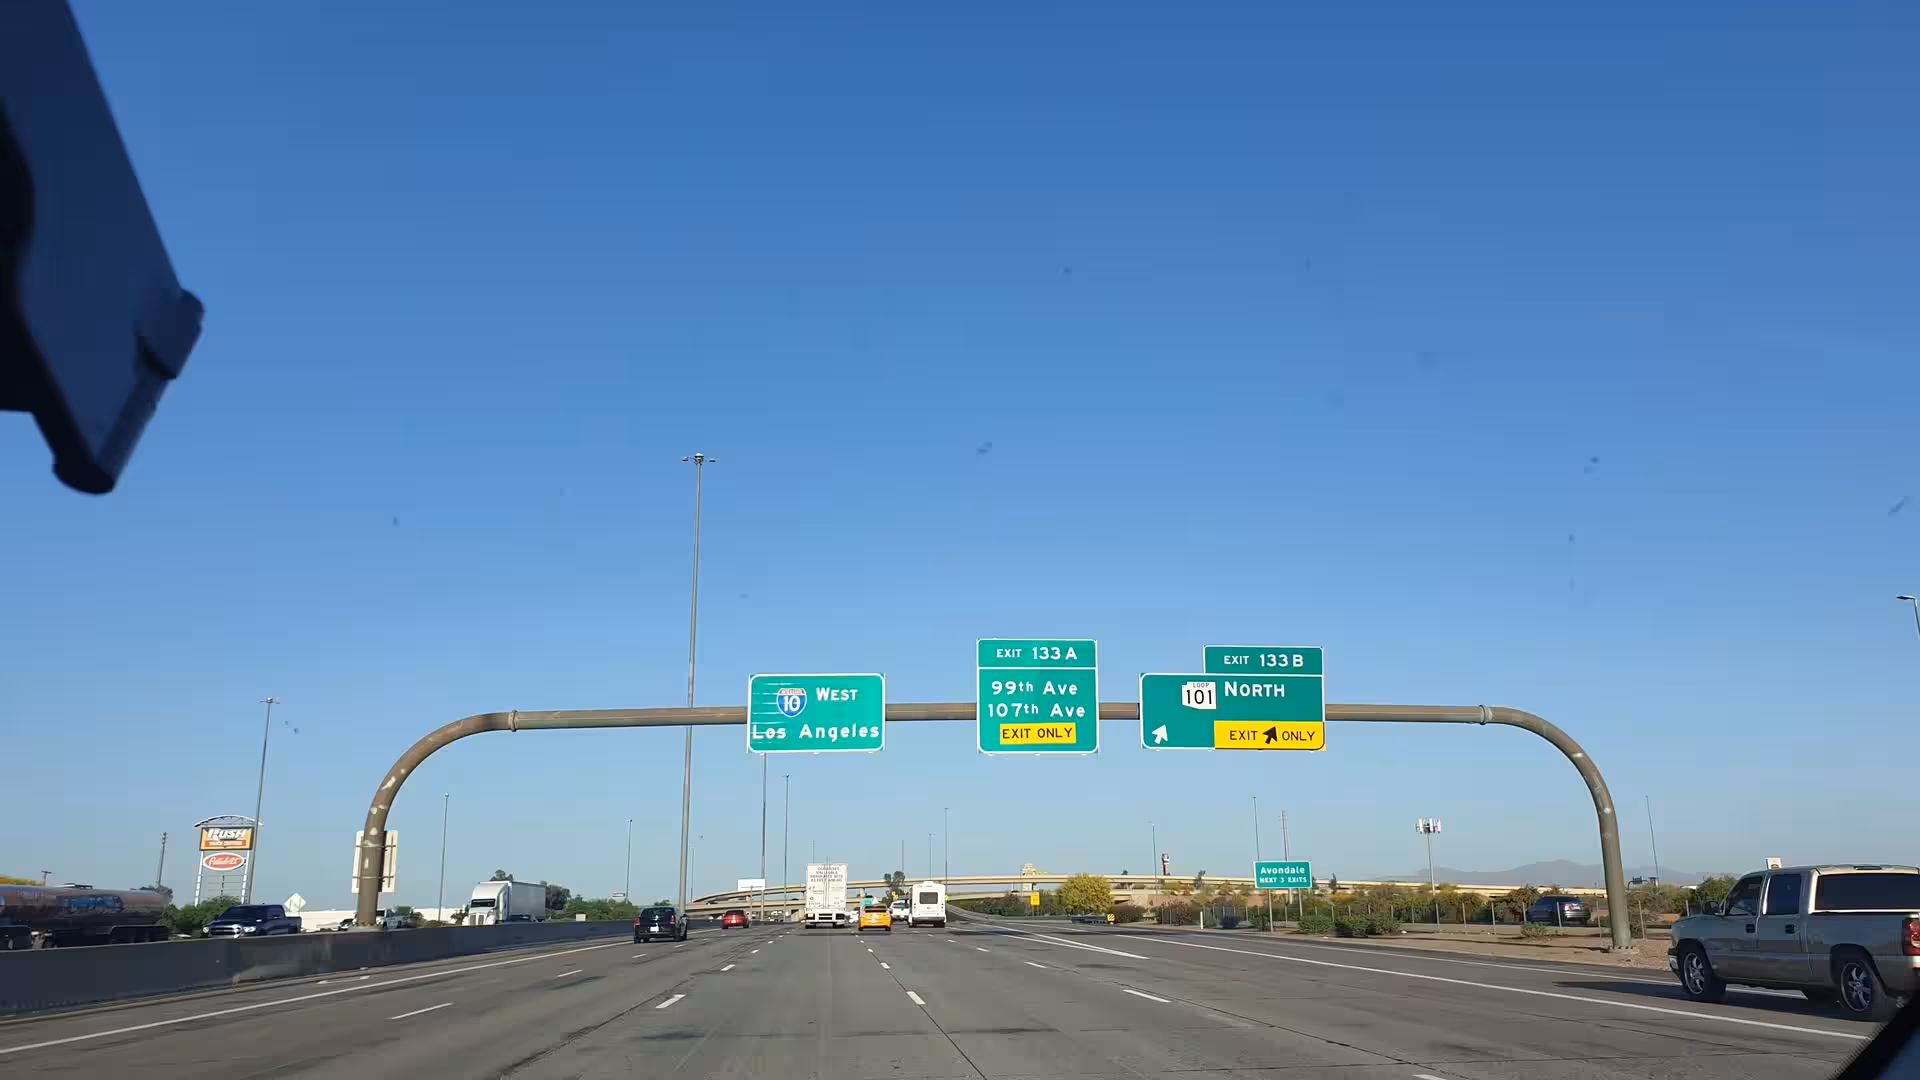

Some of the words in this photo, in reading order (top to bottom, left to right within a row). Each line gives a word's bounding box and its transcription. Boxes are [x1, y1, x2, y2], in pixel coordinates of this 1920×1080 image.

[996, 649, 1022, 659] EXIT
[1223, 655, 1250, 665] EXIT
[991, 680, 1034, 695] 99th
[1042, 680, 1078, 695] Ave
[1186, 689, 1212, 705] 101
[1224, 681, 1286, 698] NORTH
[783, 695, 801, 712] 10
[815, 687, 859, 702] WEST
[988, 702, 1039, 717] 107th
[1049, 703, 1086, 718] Ave
[752, 724, 787, 740] Los
[799, 723, 880, 742] Angeles
[1002, 728, 1031, 740] EXIT
[1036, 727, 1073, 739] ONLY
[1229, 730, 1258, 741] EXIT
[1281, 730, 1316, 741] ONLY
[1260, 866, 1305, 874] Avondale
